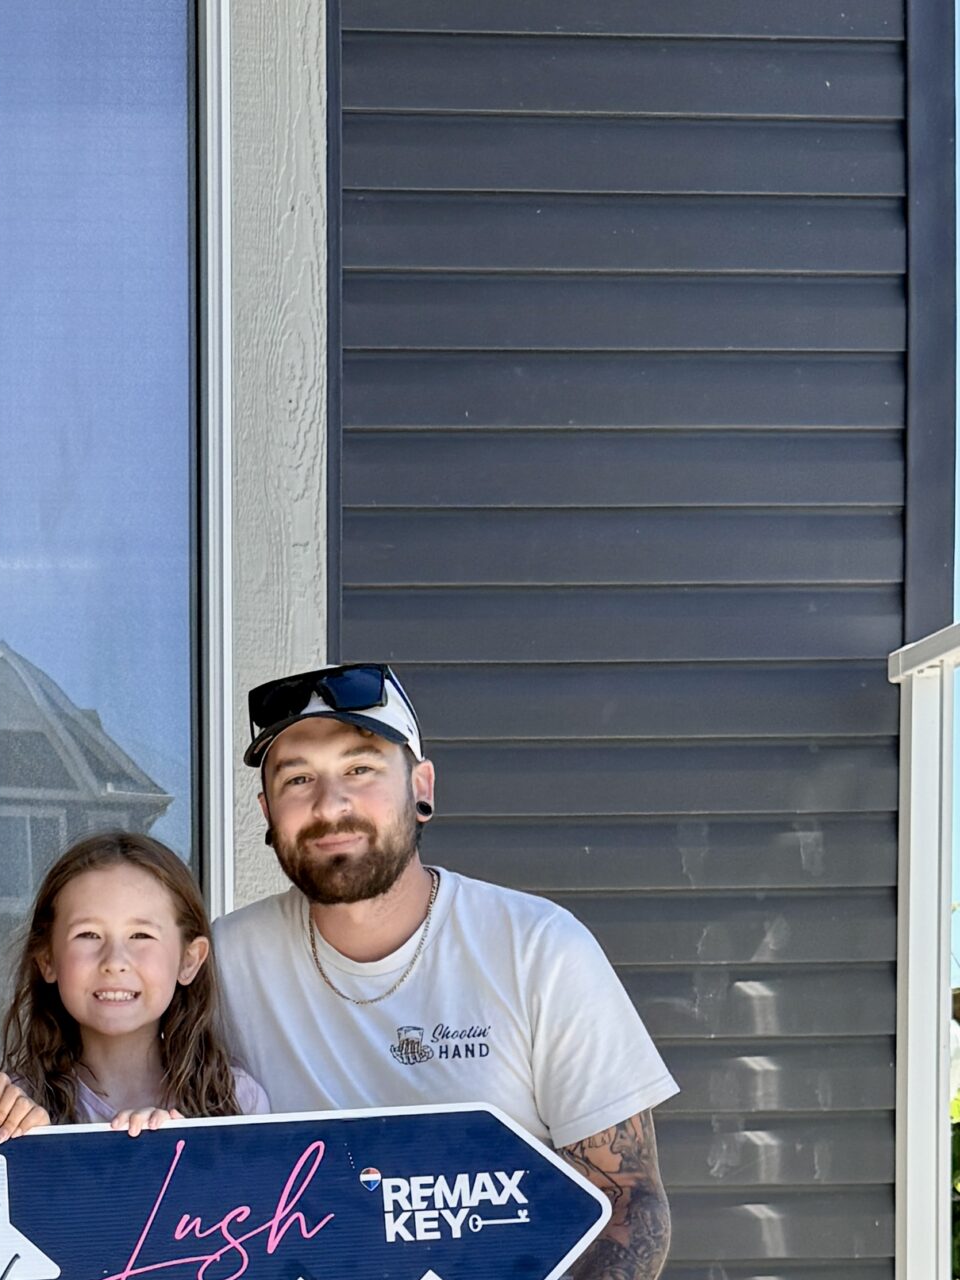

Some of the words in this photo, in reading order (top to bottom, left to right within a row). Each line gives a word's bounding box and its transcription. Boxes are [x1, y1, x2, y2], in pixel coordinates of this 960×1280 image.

[438, 1043, 490, 1059] HAND
[381, 1170, 529, 1212] REMAX
[384, 1208, 470, 1243] KEY
